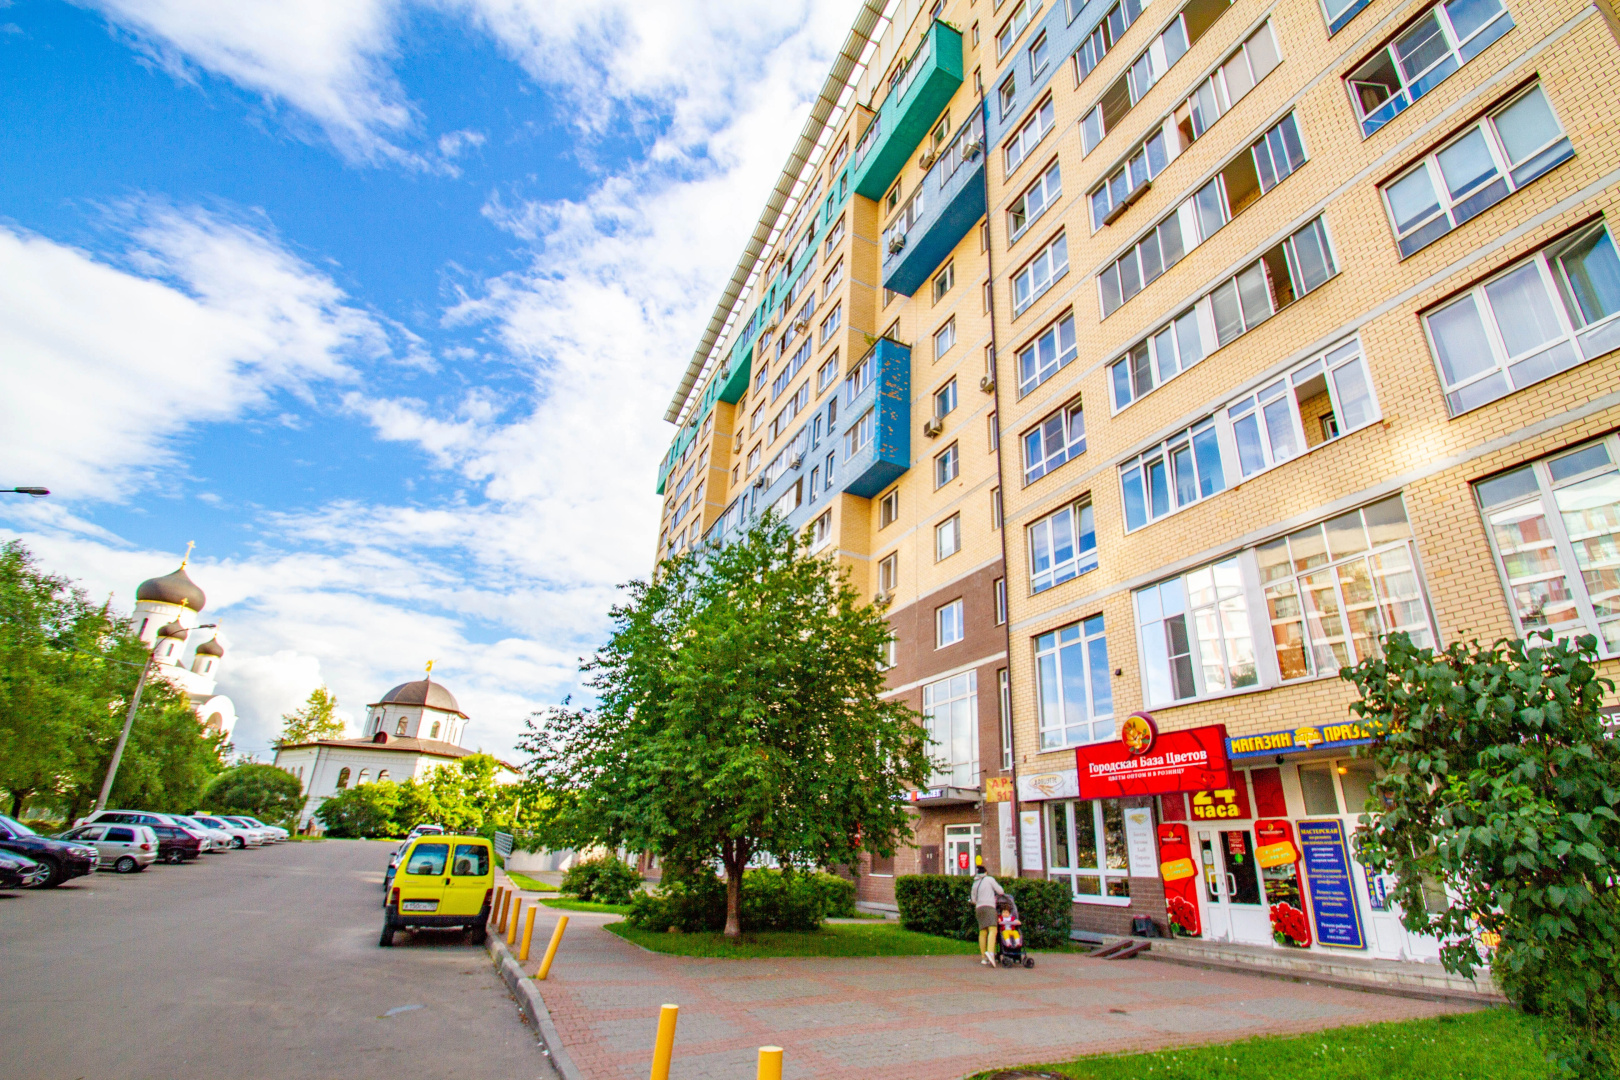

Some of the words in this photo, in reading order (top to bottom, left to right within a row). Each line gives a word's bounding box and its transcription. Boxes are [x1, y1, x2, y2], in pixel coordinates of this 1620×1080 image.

[1231, 732, 1293, 754] МАГАЗИН
[1089, 759, 1138, 774] Городская
[1140, 755, 1164, 767] База
[1166, 750, 1207, 766] Цветов
[1108, 774, 1126, 782] ЦВЕТЫ
[1127, 772, 1147, 780] ОПТОМ
[1158, 768, 1185, 776] РОЗНИЦУ
[1194, 804, 1239, 818] часа
